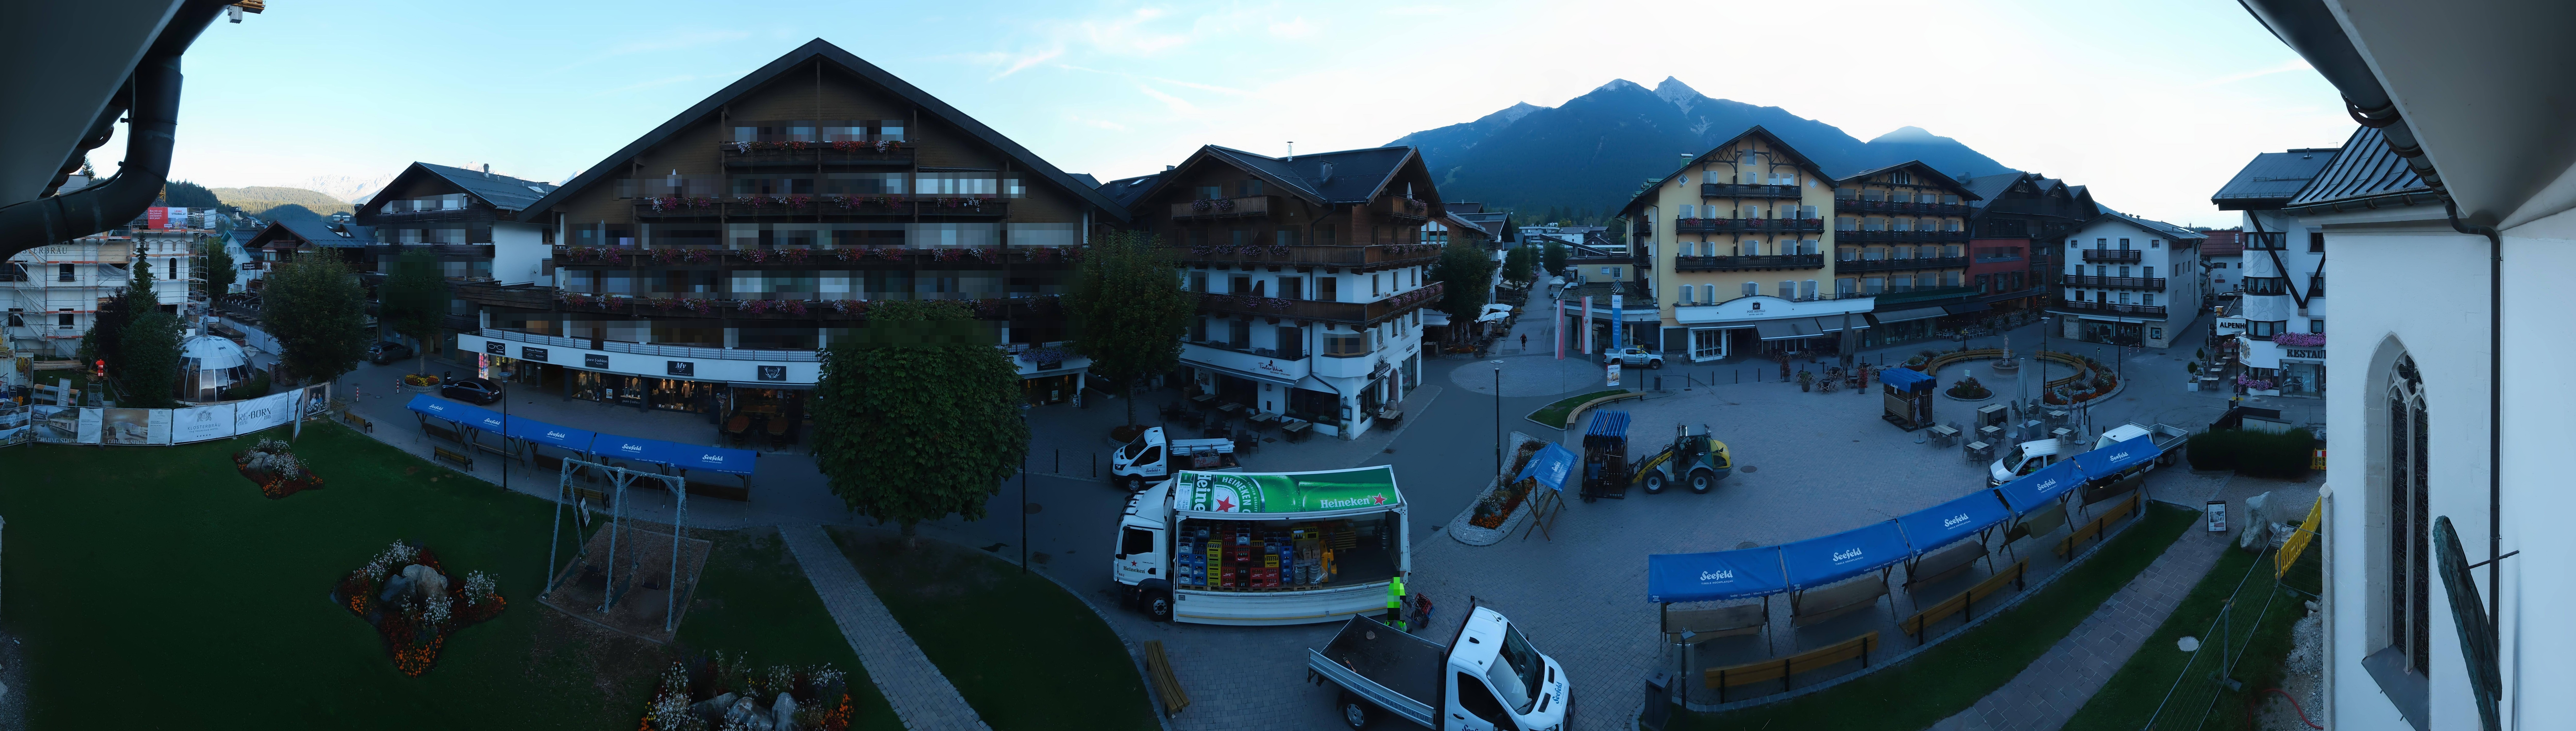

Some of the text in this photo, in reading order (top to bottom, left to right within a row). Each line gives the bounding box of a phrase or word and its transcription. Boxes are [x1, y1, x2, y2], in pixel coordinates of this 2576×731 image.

[1406, 344, 1414, 352] SAILER
[2240, 356, 2251, 365] Kaltschmid
[675, 362, 686, 372] My
[1376, 365, 1389, 378] RESTAURANT
[2110, 452, 2129, 461] Seefeld
[1645, 460, 1660, 471] KRAMER
[1247, 482, 1256, 495] PREMIUM
[2037, 478, 2056, 490] Seefeld
[1222, 477, 1251, 506] HEINEKEN
[1320, 497, 1370, 508] Heineken
[1945, 513, 1969, 527] Seefeld
[1833, 547, 1862, 561] Seefeld
[1700, 570, 1733, 581] Seefeld
[1314, 662, 1330, 673] visitseefeld
[1552, 682, 1562, 704] Seefeld
[1353, 682, 1429, 722] TEAM INFRASTRUKTUR
